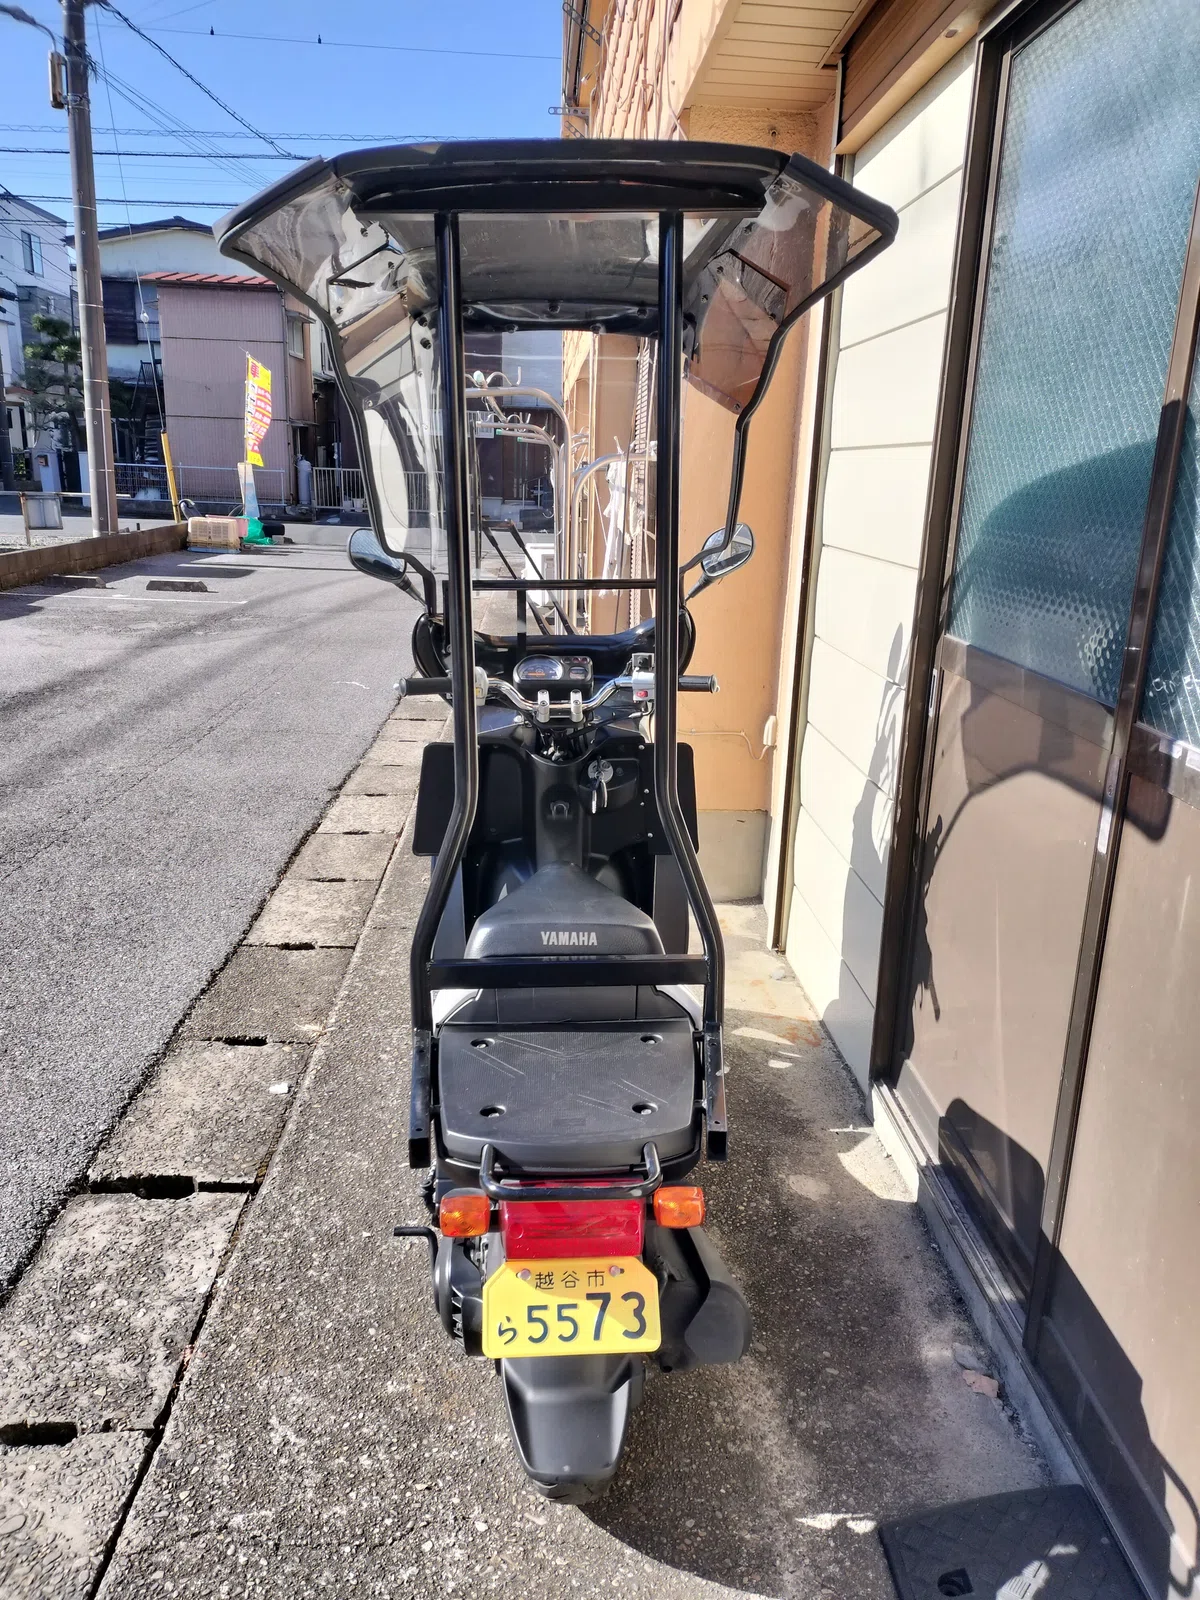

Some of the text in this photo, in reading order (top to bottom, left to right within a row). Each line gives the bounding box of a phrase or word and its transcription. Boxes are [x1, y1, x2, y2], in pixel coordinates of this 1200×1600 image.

[540, 931, 598, 946] YAMAHA
[534, 1269, 605, 1290] 越谷市
